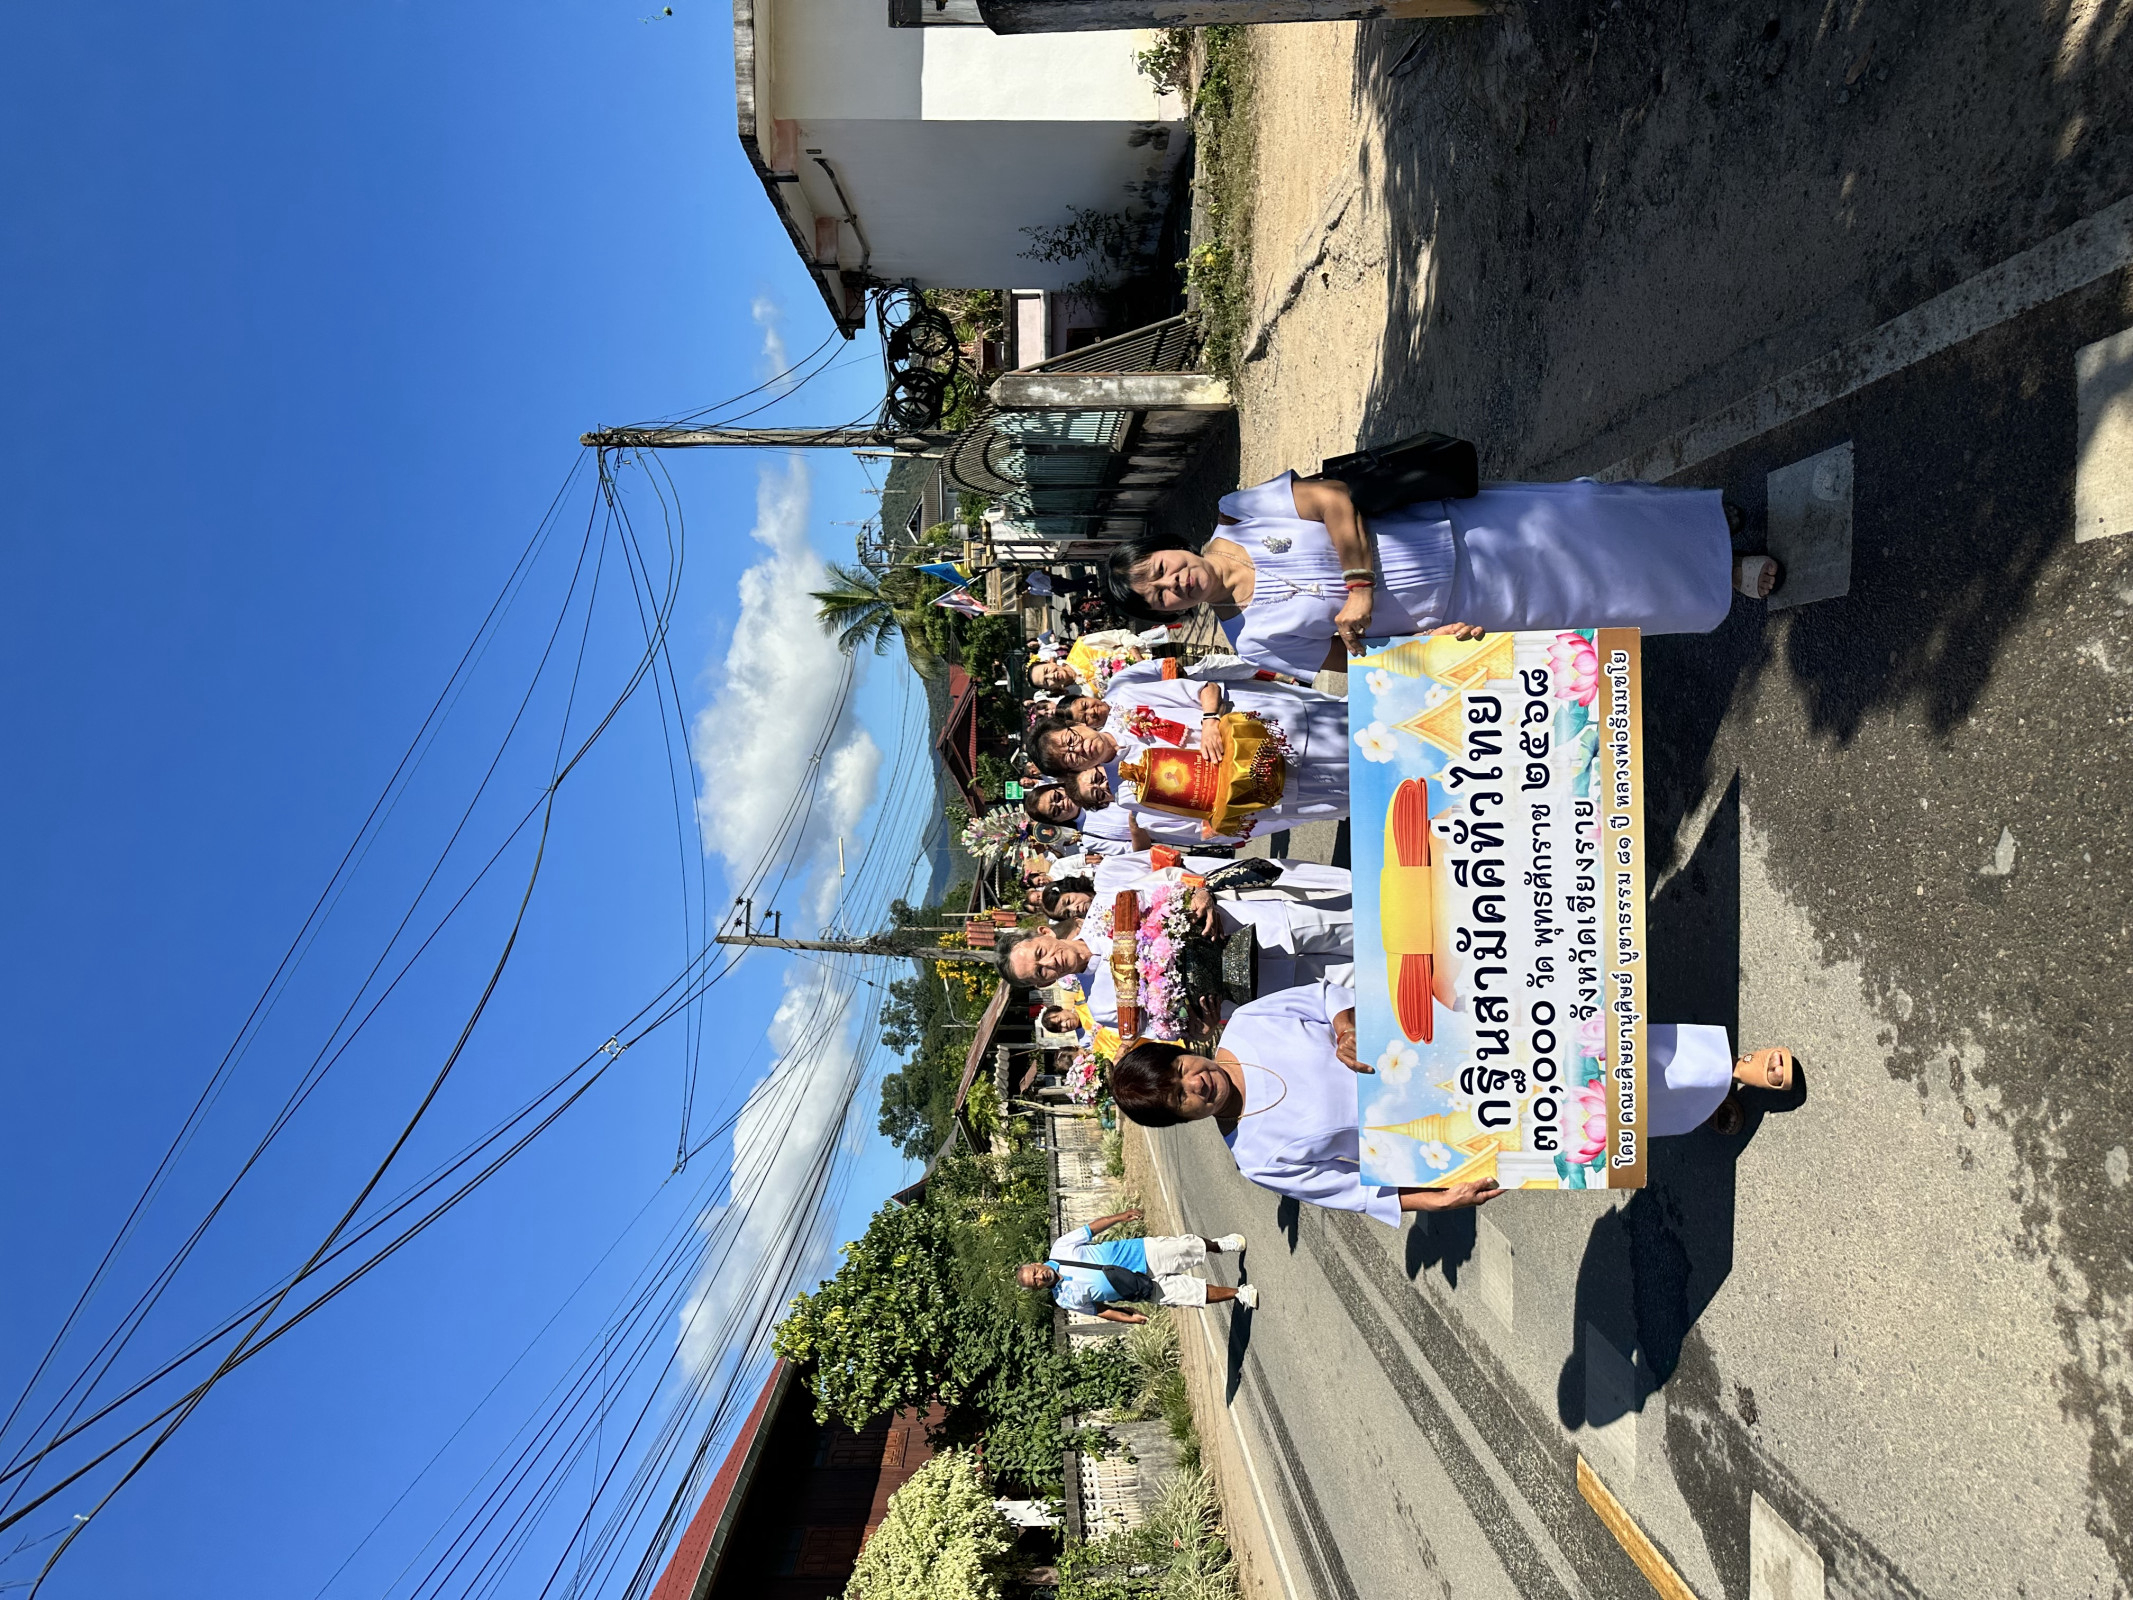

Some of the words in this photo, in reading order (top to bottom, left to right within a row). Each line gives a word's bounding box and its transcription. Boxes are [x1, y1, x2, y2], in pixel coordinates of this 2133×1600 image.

[1519, 668, 1550, 792] ๒๕๖๘
[1606, 652, 1630, 807] หลวงพ่อธัมมชโย
[1523, 803, 1565, 947] พุทธศักราช
[1609, 816, 1630, 829] ปี
[1617, 837, 1632, 865] ๘๑
[1434, 695, 1527, 1128] กฐินสามัคคีทั่วไทย
[1526, 956, 1555, 989] วัด
[1565, 801, 1598, 1022] จังหวัดเชียงราย
[1617, 873, 1639, 965] บูชาธรรม
[1531, 1000, 1564, 1151] ๓๐,๐๐๐
[1611, 973, 1640, 1123] คณะศิษยานุศิษย์
[1614, 1131, 1634, 1167] โดย
